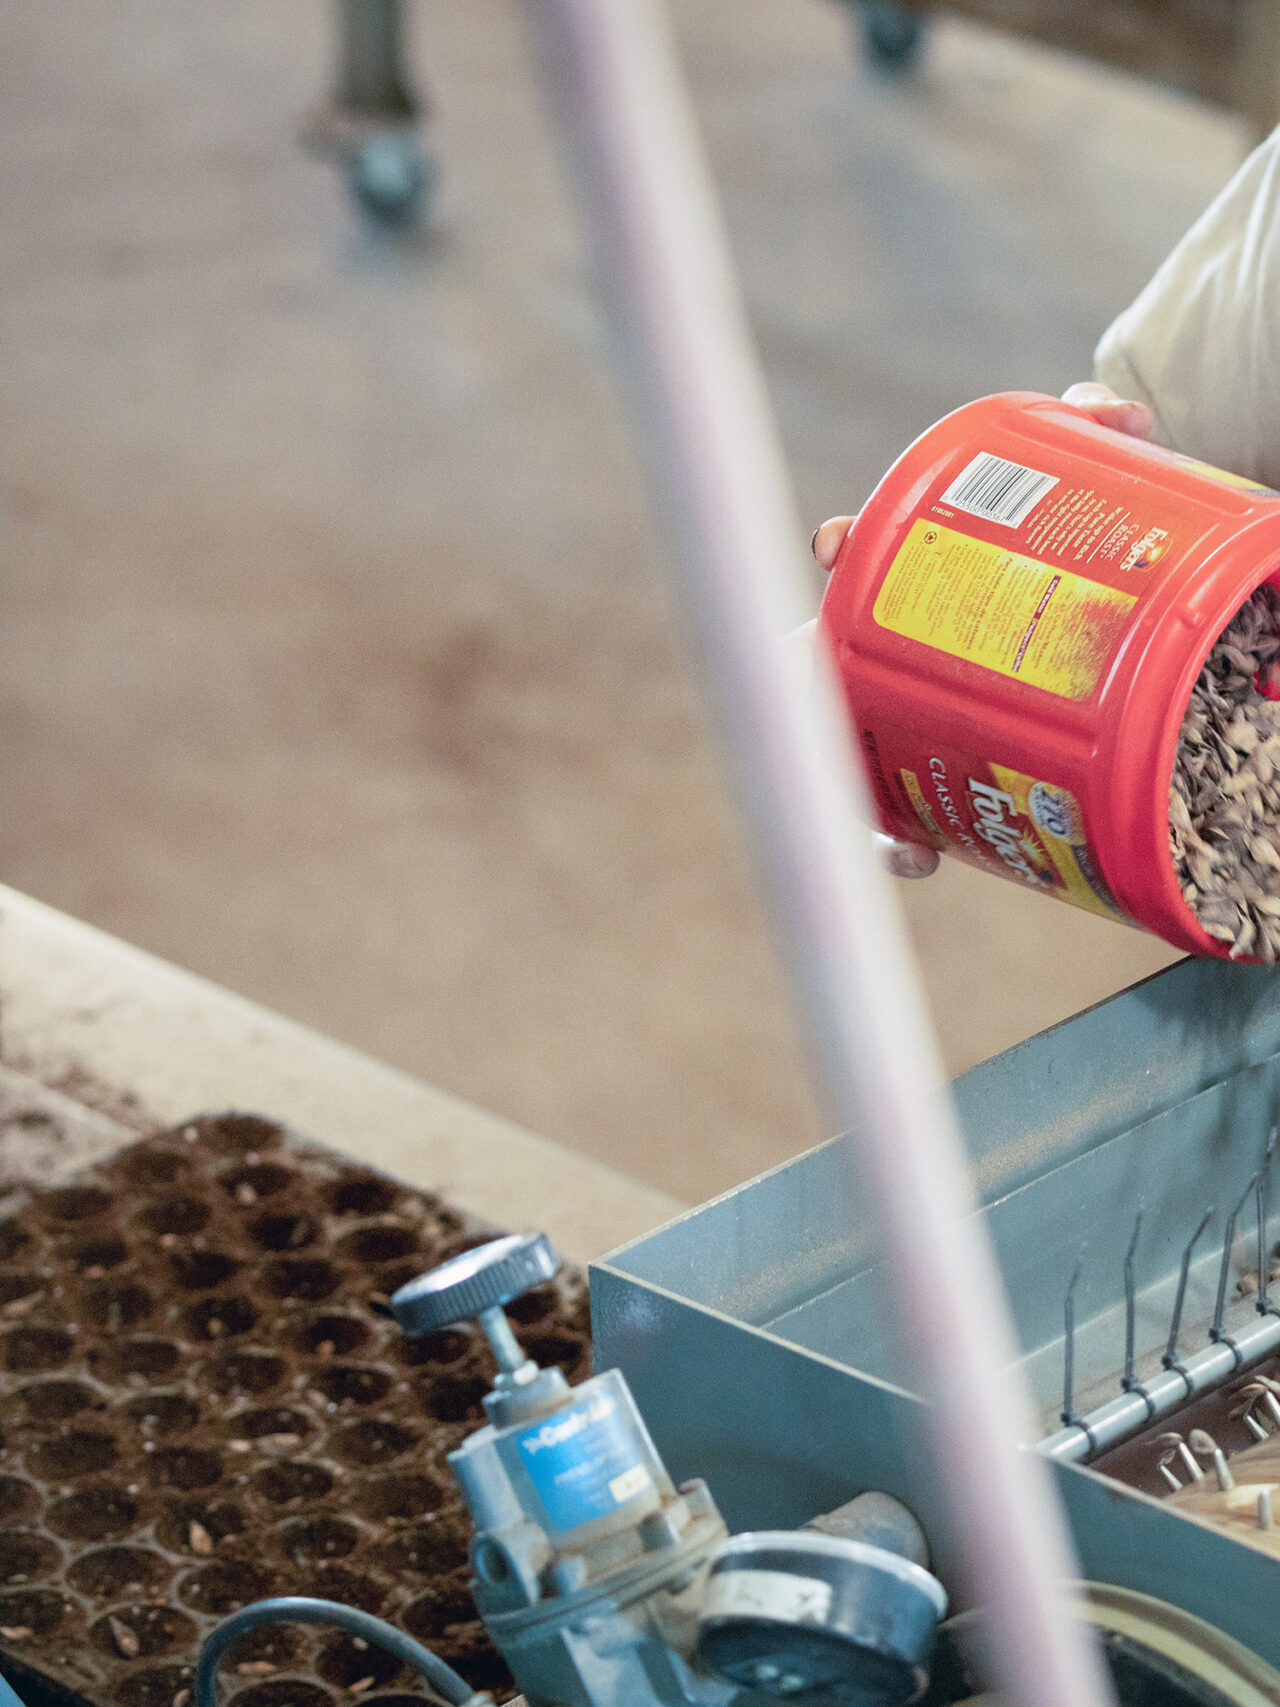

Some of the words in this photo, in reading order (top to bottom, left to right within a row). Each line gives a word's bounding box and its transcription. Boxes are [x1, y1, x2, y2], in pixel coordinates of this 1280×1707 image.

[1056, 503, 1070, 517] right
[1091, 498, 1107, 512] Each
[1039, 513, 1051, 525] rich
[1081, 511, 1093, 523] cup
[1087, 511, 1106, 528] Pure
[1101, 506, 1124, 525] Wake
[1029, 515, 1059, 551] temperature
[1047, 526, 1060, 540] each
[1055, 530, 1067, 541] why
[1091, 524, 1104, 536] up
[1056, 527, 1079, 556] important
[1072, 529, 1091, 548] Taste
[1085, 535, 1095, 544] to
[1104, 523, 1140, 561] CLASSIC
[1036, 539, 1051, 555] bean
[1118, 526, 1168, 572] Folgers
[928, 757, 966, 831] CLASSIC
[1037, 787, 1072, 839] 270
